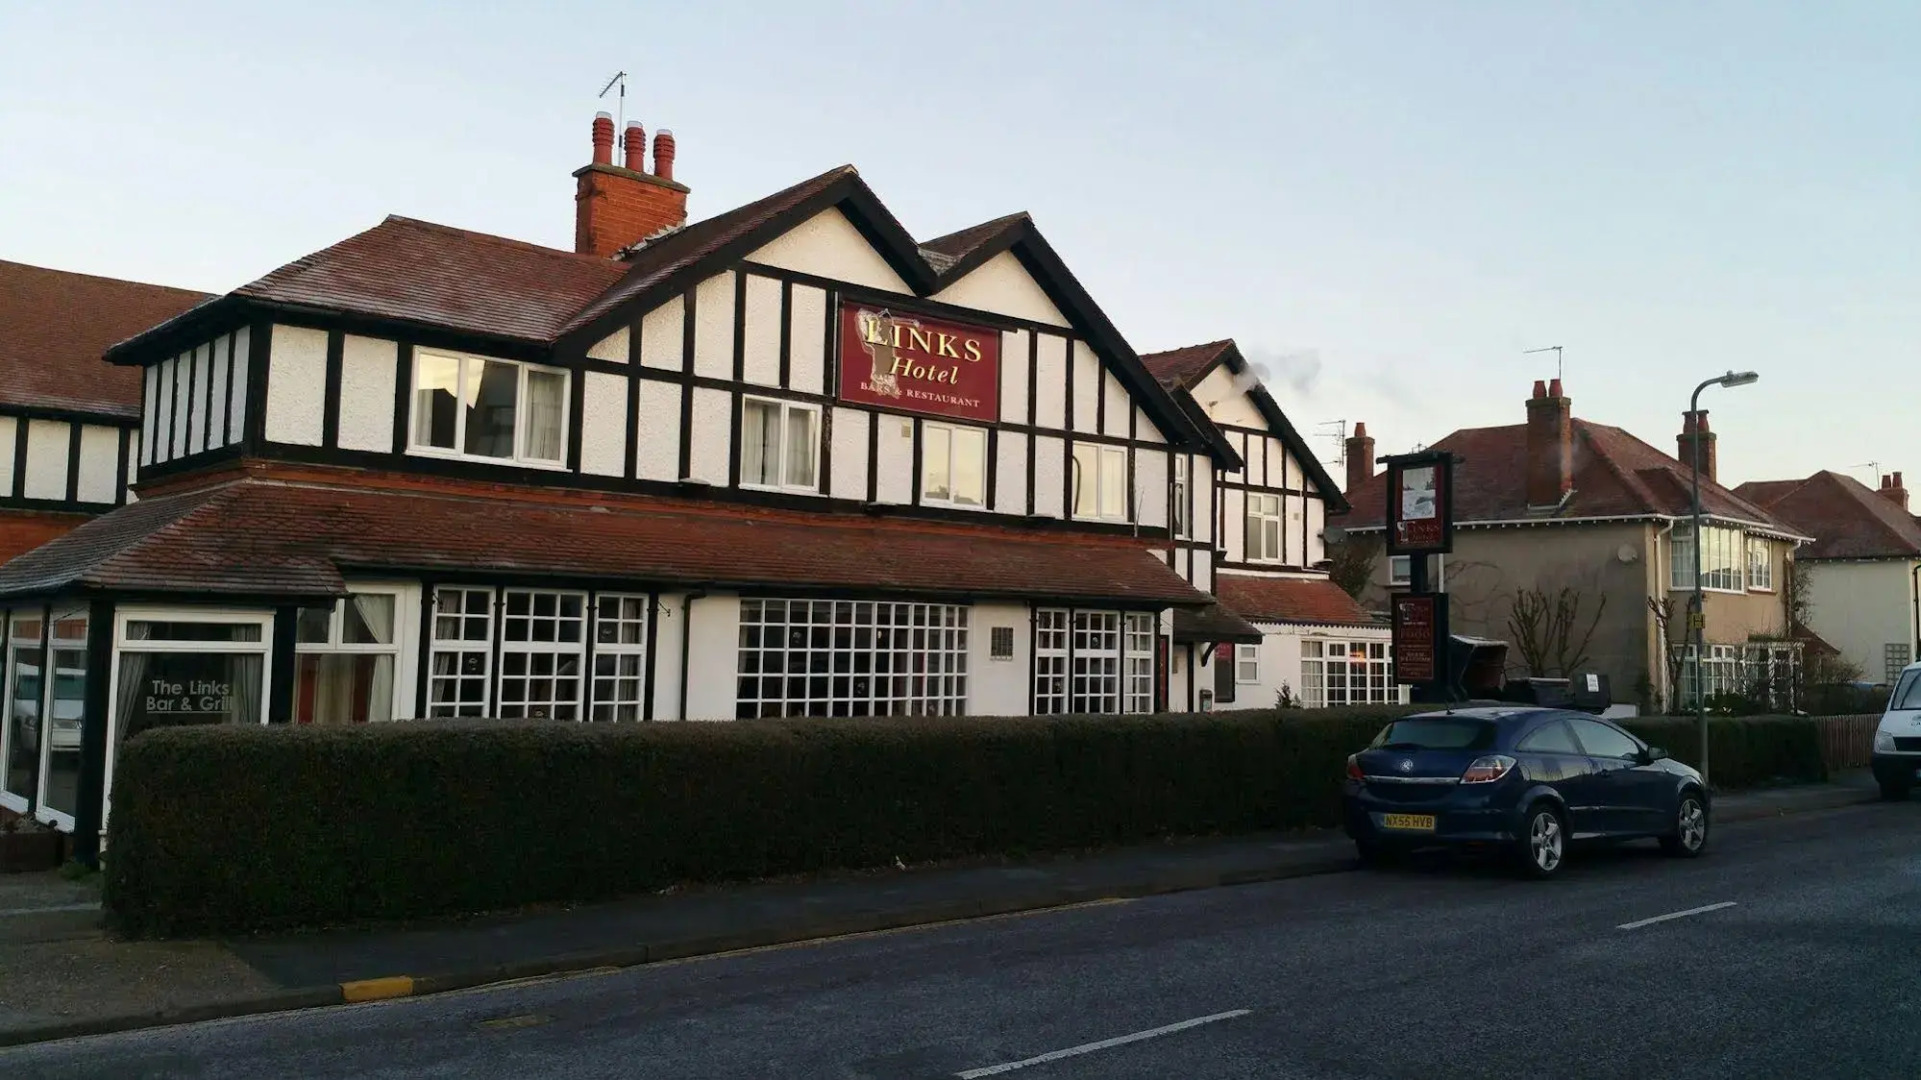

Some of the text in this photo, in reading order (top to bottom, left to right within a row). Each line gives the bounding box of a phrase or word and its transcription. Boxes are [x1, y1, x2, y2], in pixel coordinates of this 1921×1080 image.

[863, 319, 982, 362] LINKS
[889, 356, 959, 385] Hotel
[906, 389, 980, 408] RESTAURANT
[152, 680, 230, 695] The Links
[146, 696, 233, 711] Bar & Grill
